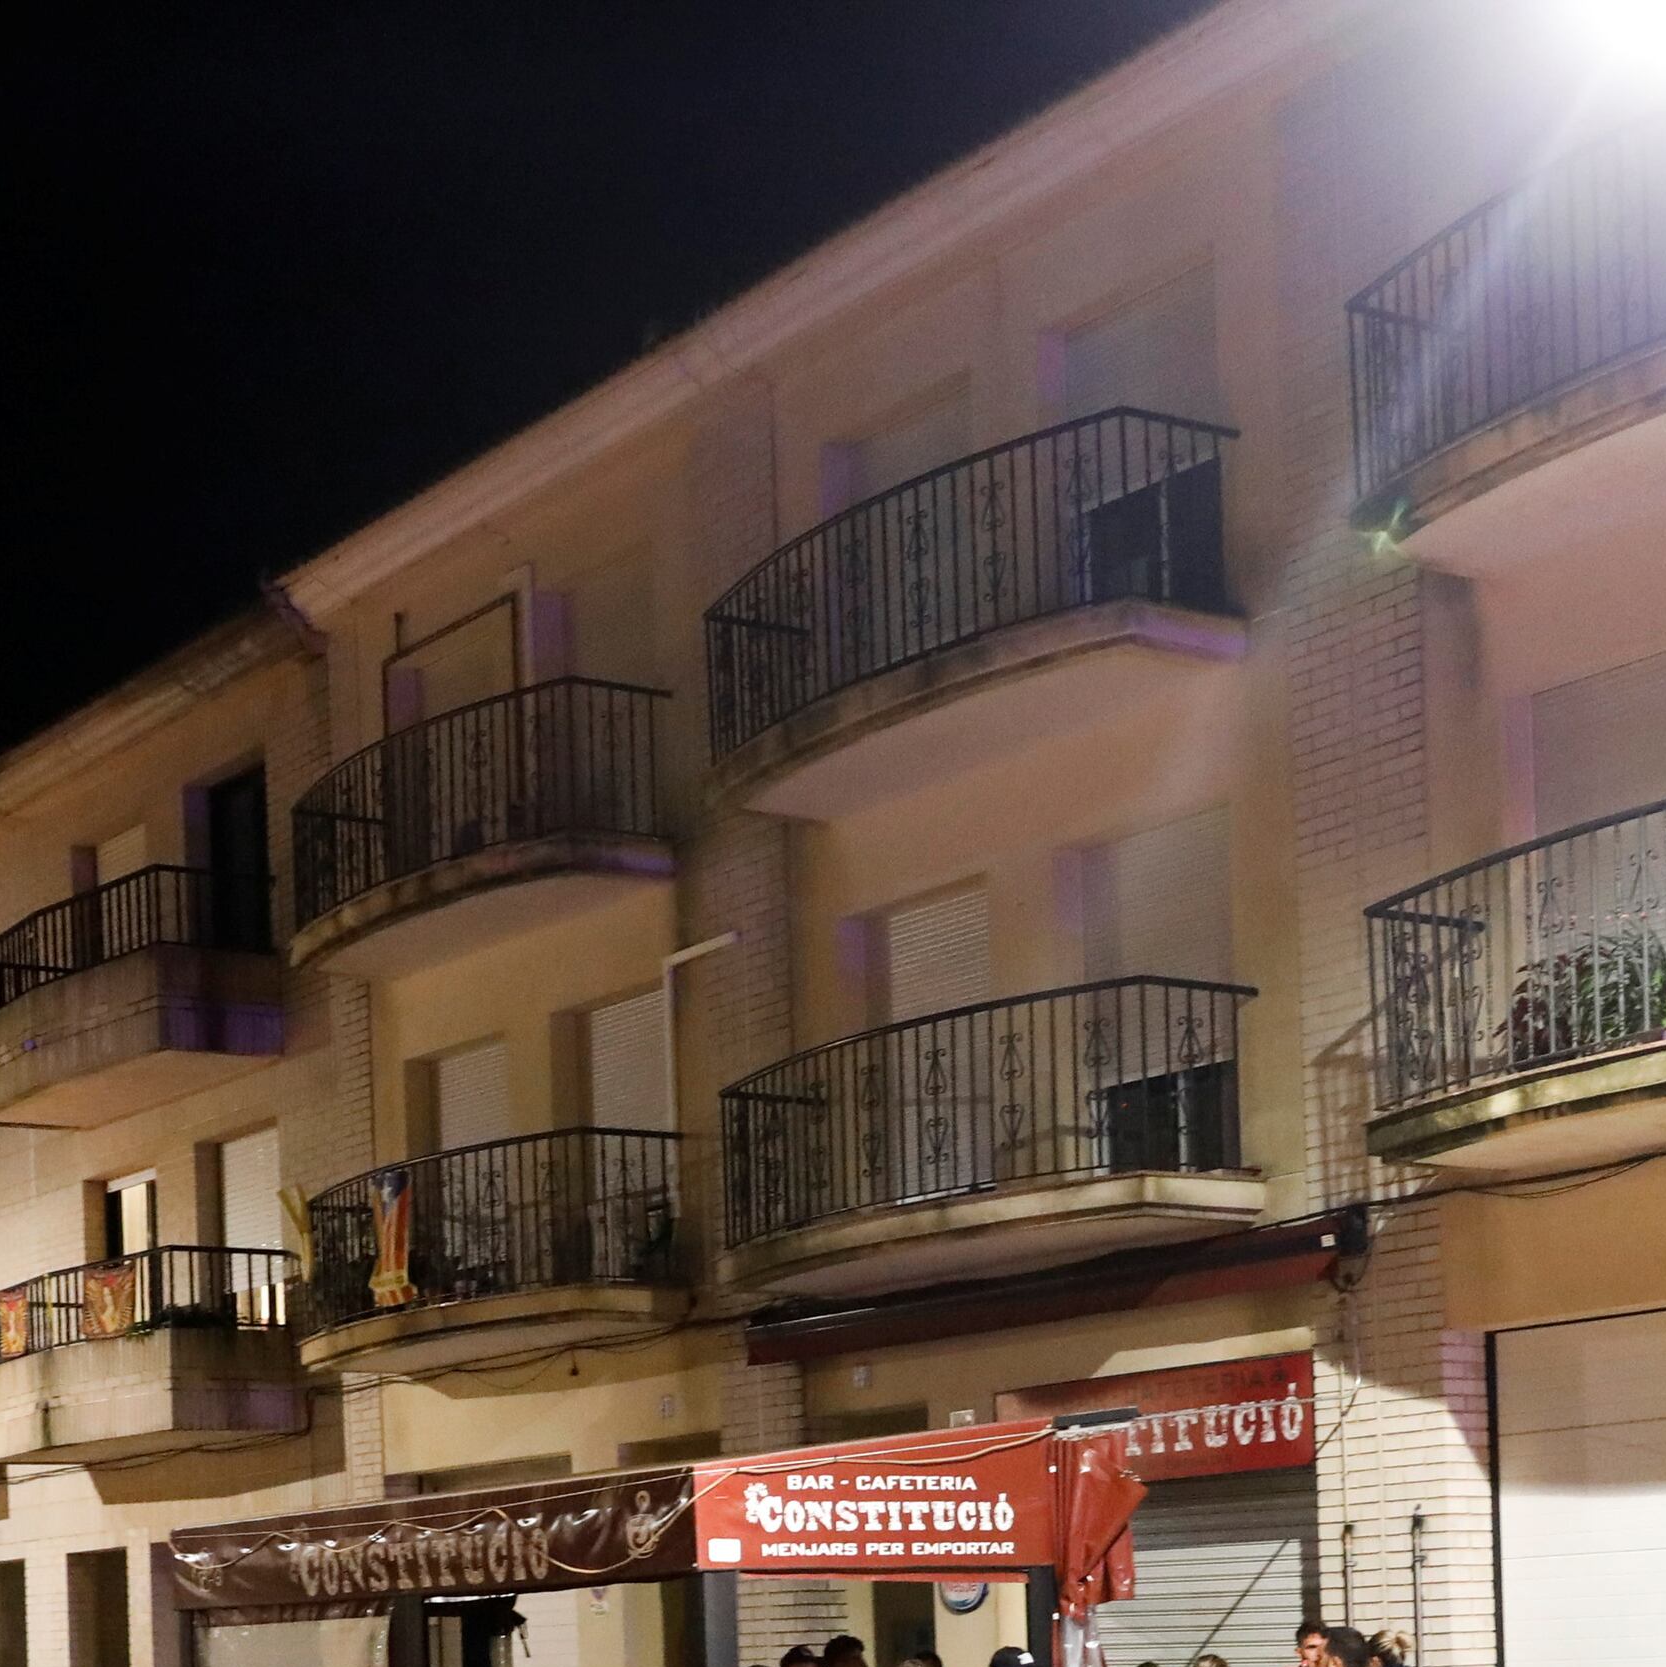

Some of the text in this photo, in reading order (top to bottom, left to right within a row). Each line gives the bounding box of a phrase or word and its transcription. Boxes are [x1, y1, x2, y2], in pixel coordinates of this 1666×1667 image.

[1125, 1382, 1304, 1456] TITUCIÓ
[786, 1474, 834, 1491] BAR
[855, 1475, 978, 1491] CAFETERIA
[757, 1492, 1015, 1533] CONSTITUCIÓ
[761, 1541, 1015, 1557] MENJARS PER EMPORTAR
